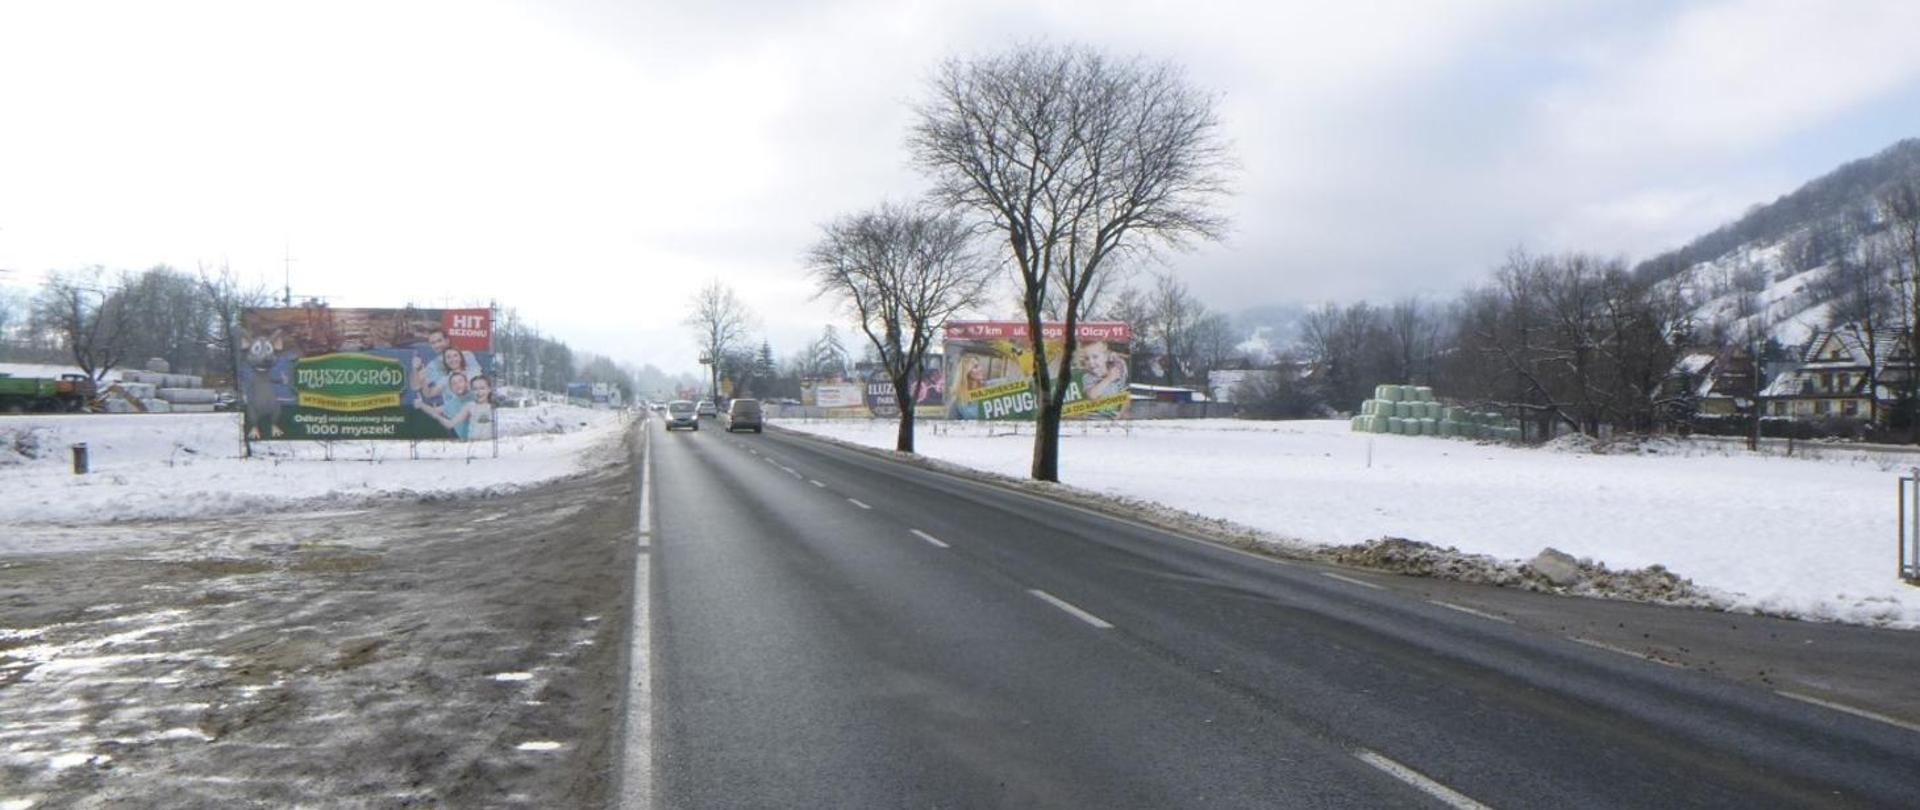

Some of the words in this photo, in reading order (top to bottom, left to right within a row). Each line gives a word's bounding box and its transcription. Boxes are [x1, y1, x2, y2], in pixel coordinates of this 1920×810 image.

[453, 315, 485, 328] HIT
[448, 328, 487, 337] SEZONU
[1013, 325, 1028, 336] ul.
[1081, 326, 1110, 338] Olczy
[1111, 326, 1124, 336] 11
[297, 367, 402, 388] MYSZOGRÓD
[295, 414, 328, 424] Odkryj
[306, 424, 339, 434] 1000
[341, 424, 395, 436] myszek!
